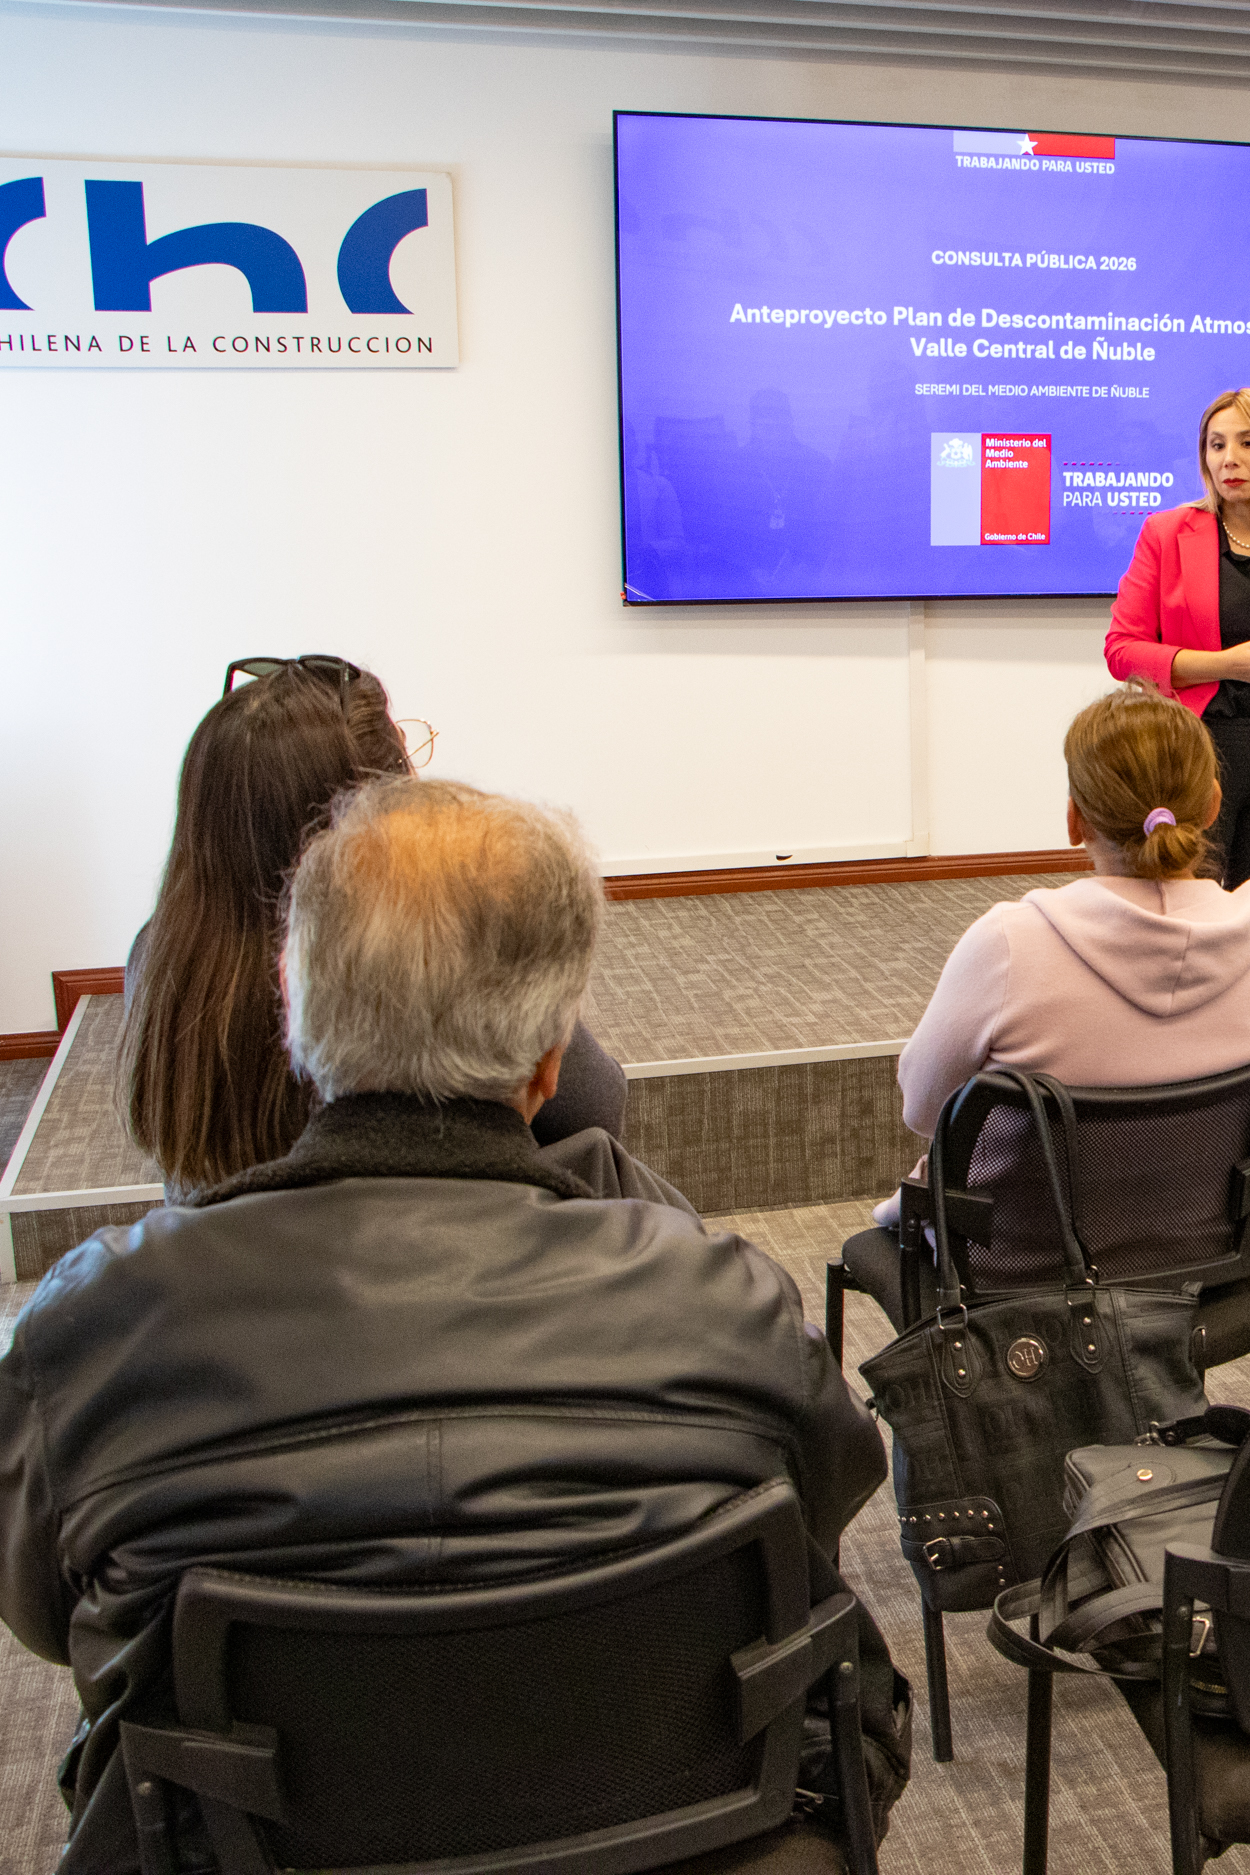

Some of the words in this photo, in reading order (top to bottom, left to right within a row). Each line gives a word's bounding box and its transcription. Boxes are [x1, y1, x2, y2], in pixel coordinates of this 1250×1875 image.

[955, 155, 1039, 171] TRABAJANDO
[1042, 159, 1072, 172] PARA
[1076, 161, 1115, 174] USTED
[931, 250, 1023, 267] CONSULTA
[1026, 250, 1097, 269] PÚBLICA
[1099, 256, 1137, 271] 2026
[729, 303, 887, 328] Anteproyecto
[893, 306, 942, 326] Plan
[948, 308, 975, 327] de
[981, 308, 1185, 333] Descontaminación
[0, 334, 102, 352] HILENA
[119, 335, 150, 352] DE
[167, 335, 197, 353] LA
[212, 336, 434, 353] CONSTRUCCION
[910, 337, 967, 357] Valle
[972, 339, 1054, 359] Central
[1060, 341, 1086, 360] de
[1092, 337, 1155, 361] Ñuble
[915, 383, 960, 395] SEREMI
[963, 384, 985, 396] DEL
[988, 384, 1028, 396] MEDIO
[1030, 385, 1090, 397] AMBIENTE
[1092, 386, 1108, 397] DE
[1110, 384, 1150, 398] ÑUBLE
[985, 438, 1031, 447] Ministerio
[1032, 439, 1047, 447] del
[985, 449, 1014, 457] Medio
[985, 459, 1028, 468] Ambiente
[1063, 471, 1174, 487] TRABAJANDO
[1063, 492, 1102, 506] PARA
[1107, 491, 1162, 507] USTED
